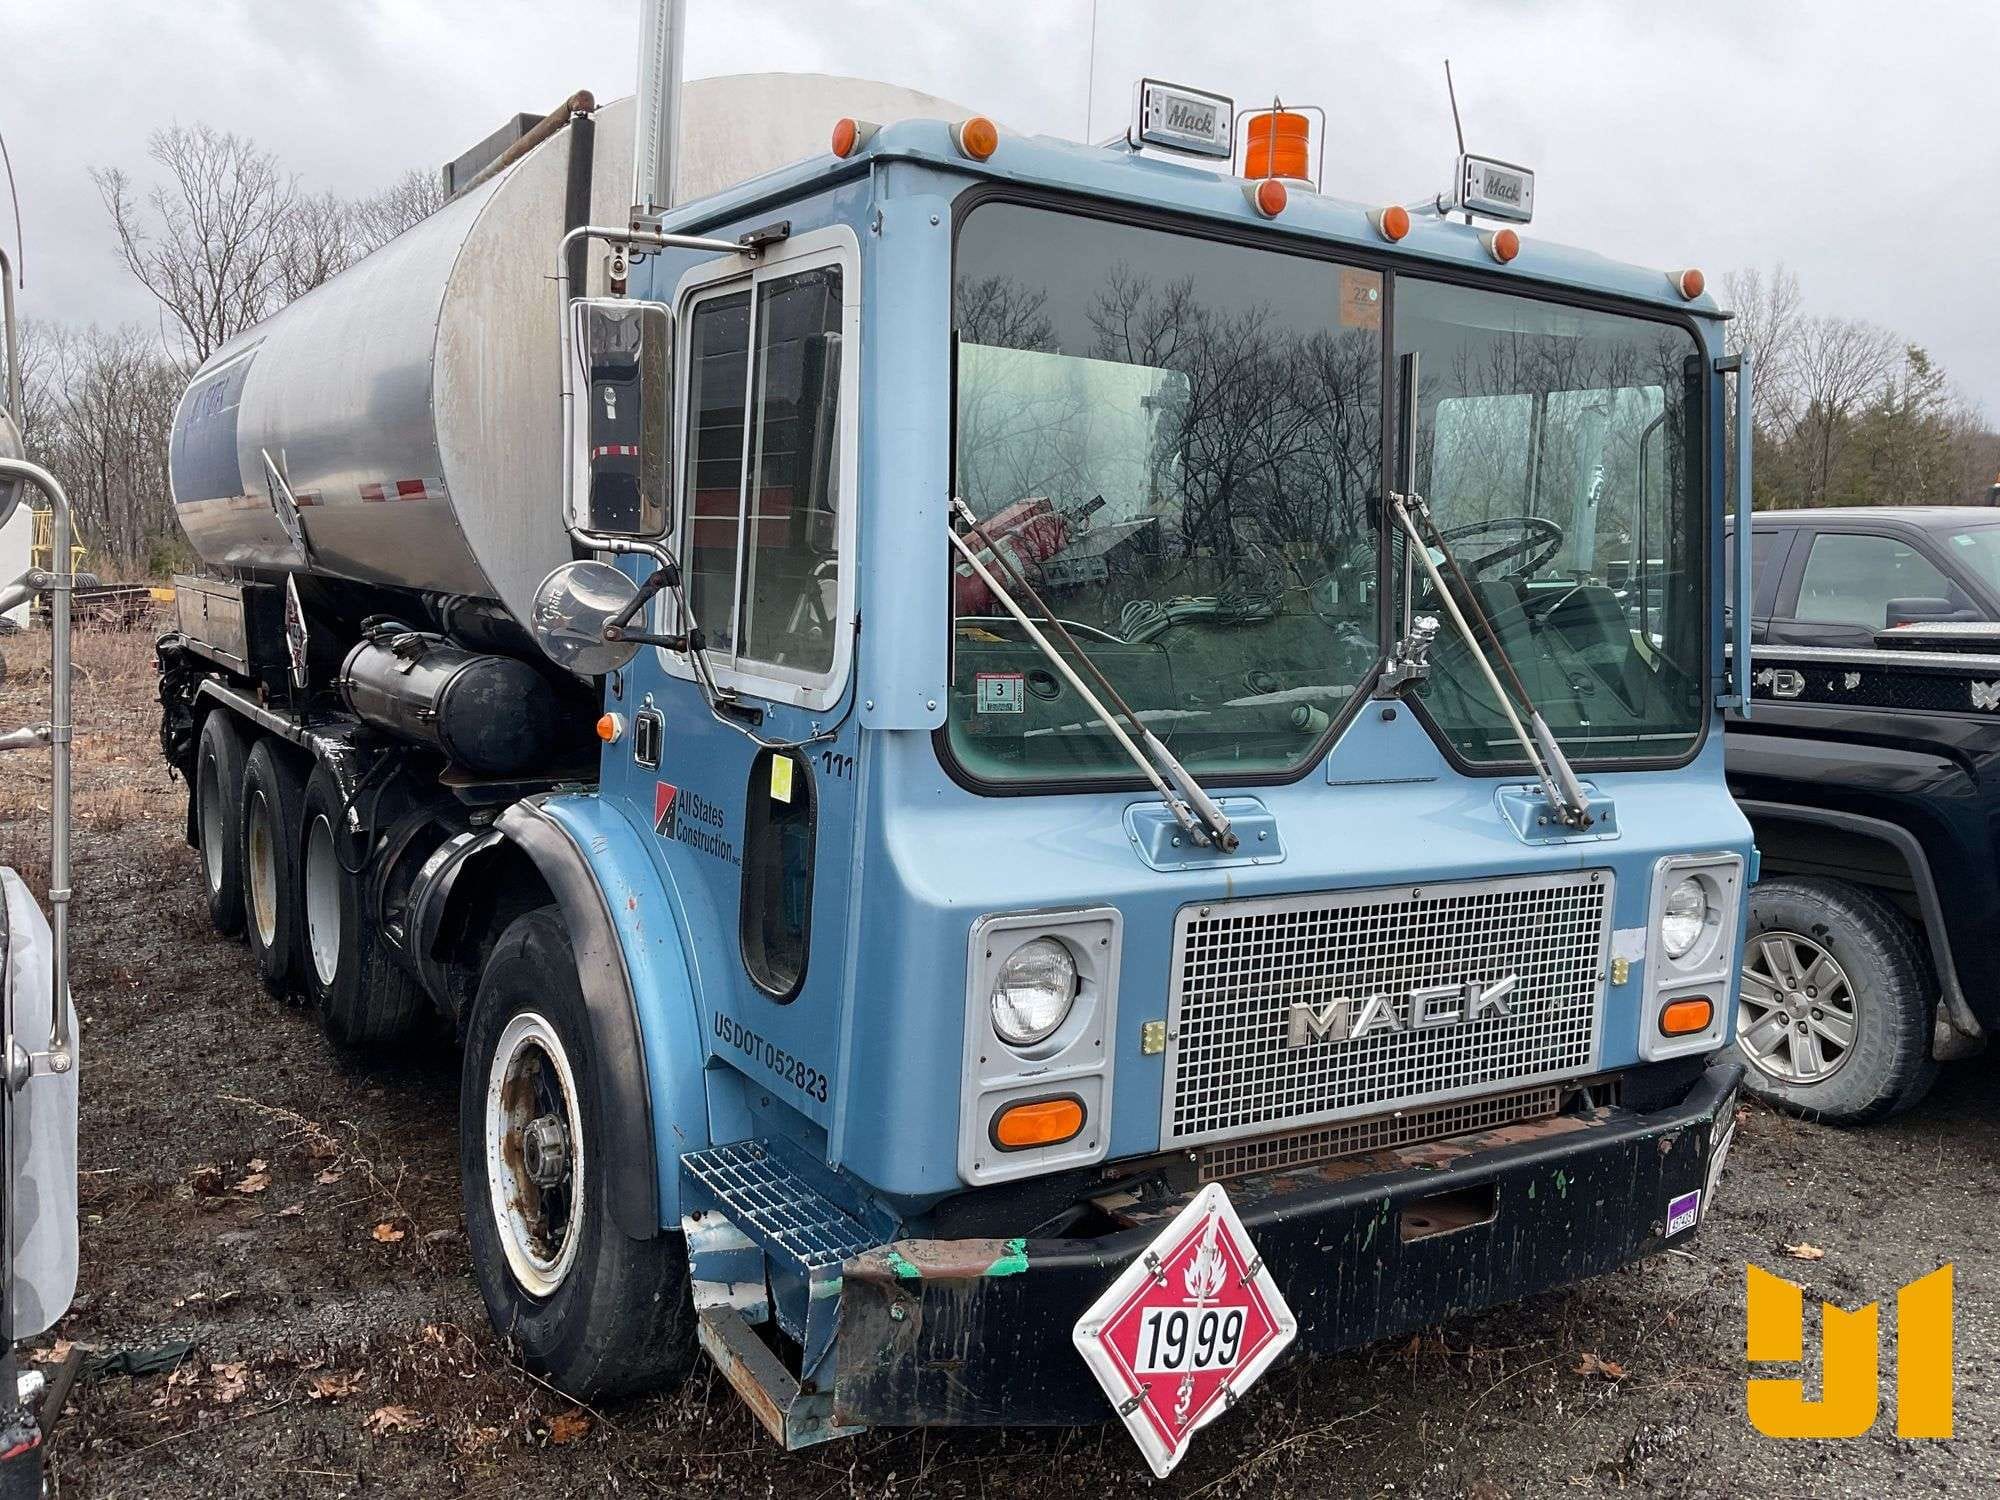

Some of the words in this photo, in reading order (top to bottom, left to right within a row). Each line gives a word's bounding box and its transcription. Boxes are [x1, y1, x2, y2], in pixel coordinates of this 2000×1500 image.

[1167, 104, 1212, 134] Mack
[1485, 175, 1519, 201] Mack
[995, 683, 1004, 696] 3
[821, 750, 853, 781] 111
[677, 790, 691, 814] All
[691, 793, 724, 829] States
[676, 819, 733, 864] Construction
[1287, 973, 1519, 1050] MACK
[765, 1043, 828, 1103] 052823
[1147, 1309, 1243, 1370] 1999
[1173, 1384, 1193, 1415] 3
